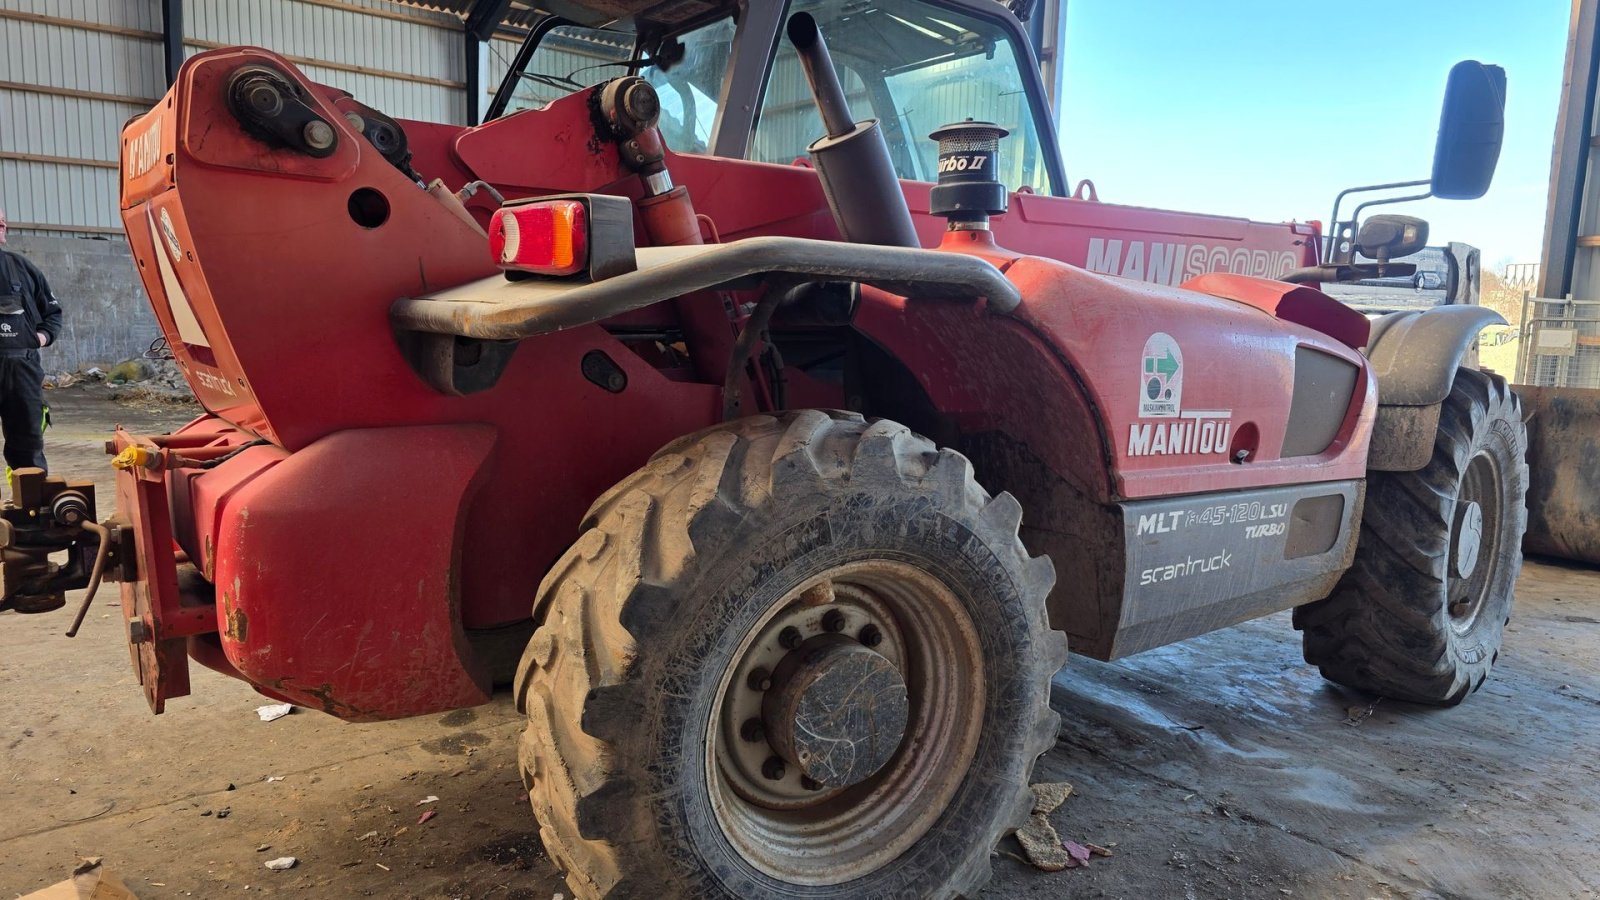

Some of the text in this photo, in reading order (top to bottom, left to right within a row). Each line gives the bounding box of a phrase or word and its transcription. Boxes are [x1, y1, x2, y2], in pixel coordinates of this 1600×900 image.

[939, 155, 967, 173] urbo
[1127, 410, 1231, 457] MANITOU
[1137, 510, 1184, 536] MLT
[1245, 522, 1286, 539] TURBO
[1140, 549, 1232, 586] scantruck
